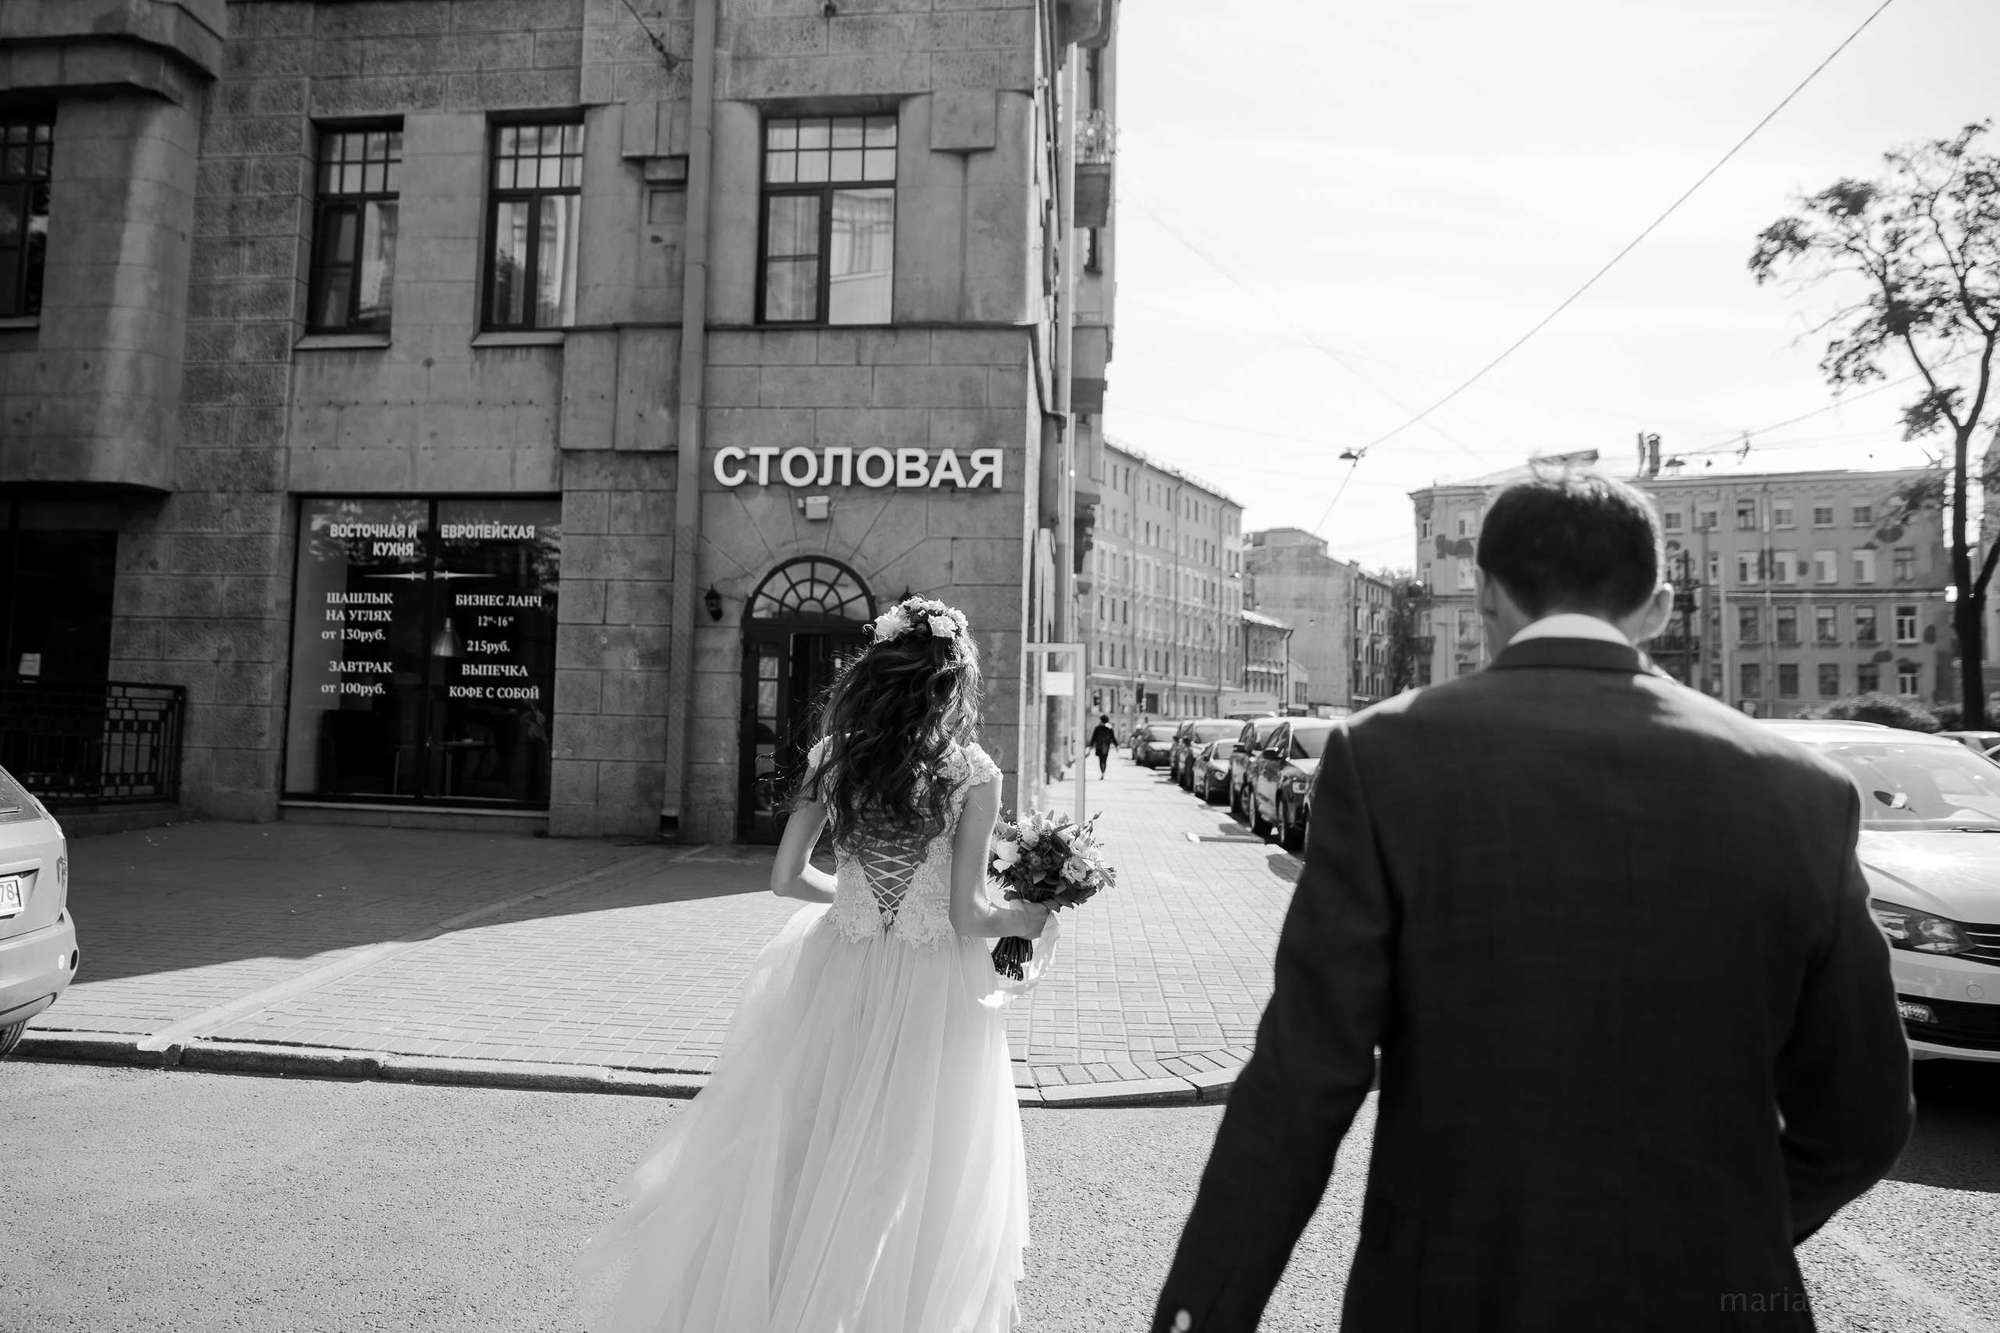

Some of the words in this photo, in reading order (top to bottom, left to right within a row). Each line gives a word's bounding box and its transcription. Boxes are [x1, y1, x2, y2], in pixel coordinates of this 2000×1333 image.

[713, 446, 1003, 488] СТОЛОВАЯ
[330, 523, 406, 538] ВОСТОЧНАЯ
[407, 523, 418, 539] И
[441, 521, 535, 539] ЕВРОПЕЙСКАЯ
[372, 542, 415, 556] КУХНЯ
[326, 591, 394, 604] ШАШЛЫК
[455, 594, 504, 606] БИЗНЕС
[506, 595, 542, 608] ЛАНЧ
[326, 609, 346, 621] НА
[348, 609, 393, 621] УГЛЯХ
[321, 630, 337, 640] от
[466, 640, 511, 655] 215руб.
[328, 660, 393, 673] ЗАВТРАК
[461, 663, 529, 677] ВЫПЕЧКА
[321, 684, 337, 694] от
[340, 682, 387, 697] 100руб.
[449, 685, 483, 698] КОФЕ
[485, 687, 495, 698] С
[496, 685, 540, 700] СОБОЙ
